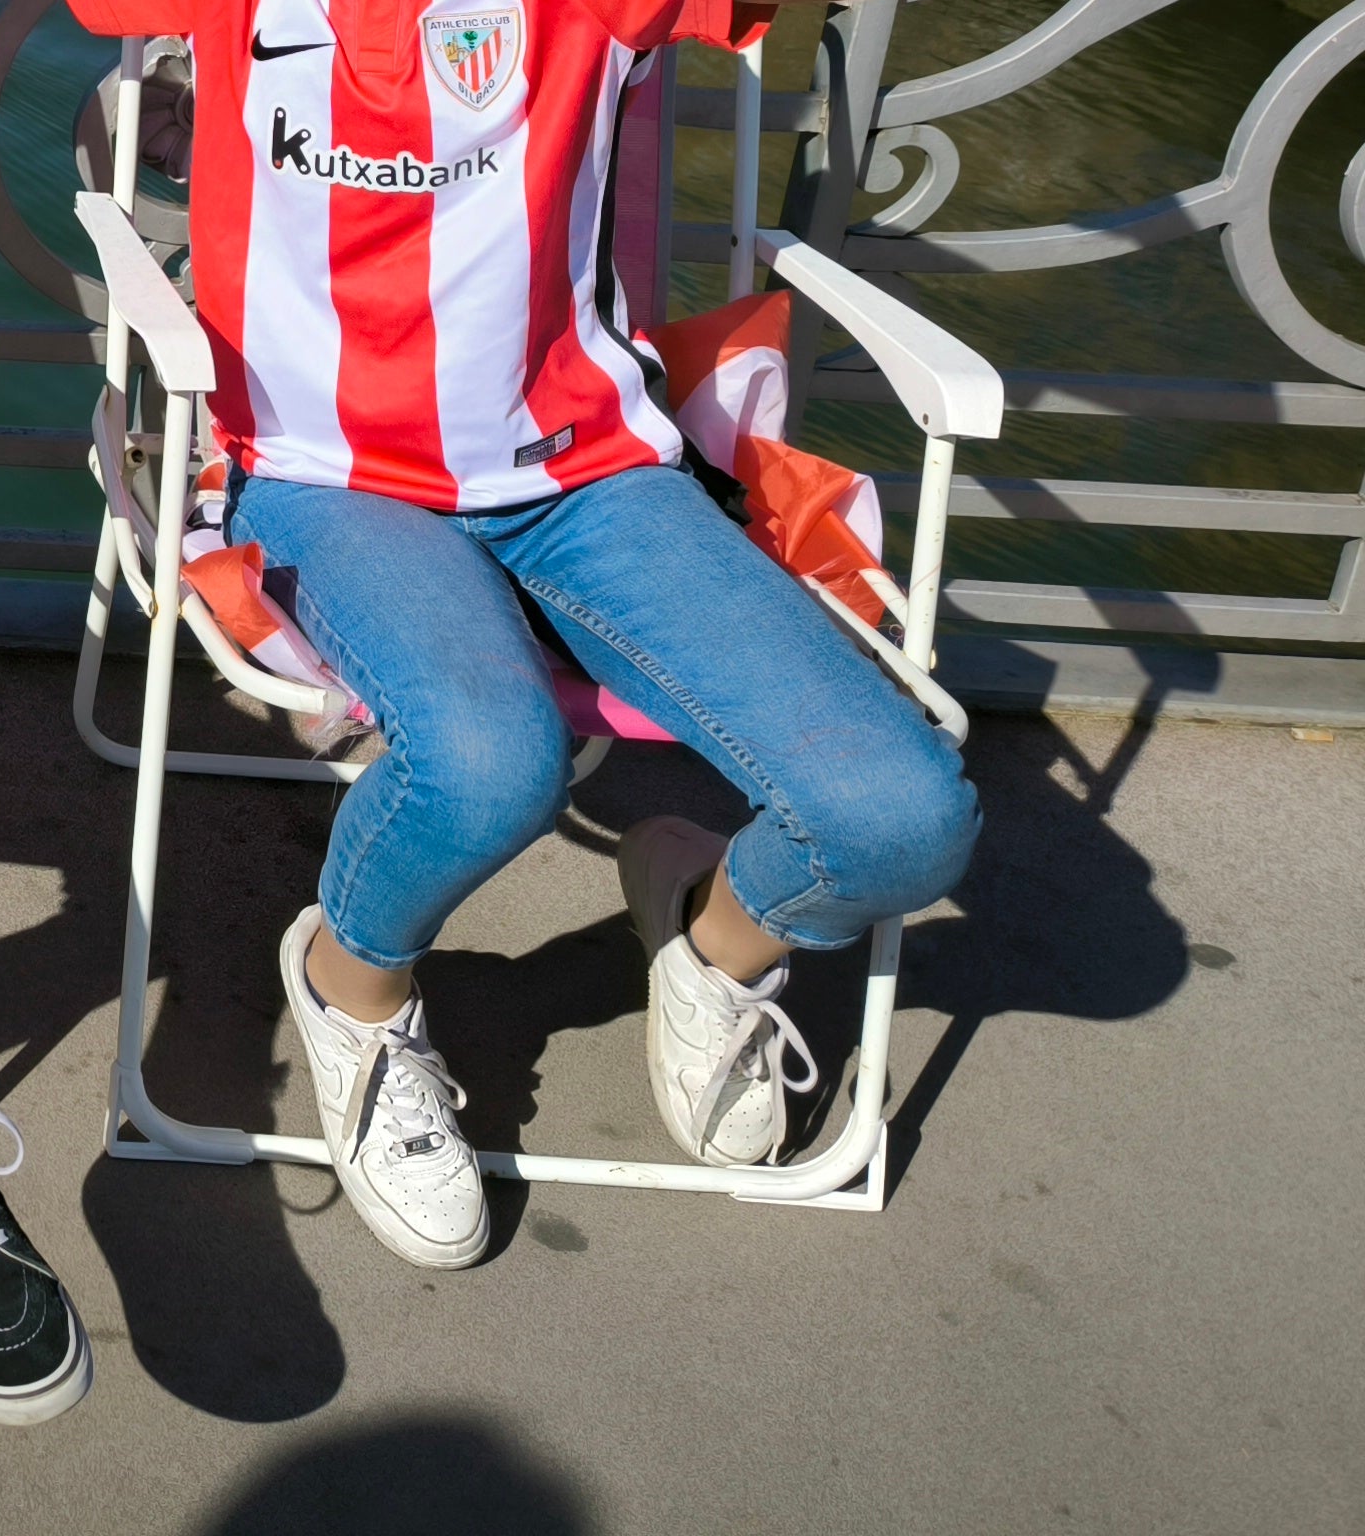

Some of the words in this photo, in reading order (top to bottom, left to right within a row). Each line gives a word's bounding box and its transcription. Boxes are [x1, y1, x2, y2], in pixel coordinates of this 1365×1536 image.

[430, 18, 480, 31] ATHLETIC
[481, 16, 511, 26] CLUB
[457, 79, 496, 105] BILBAO
[271, 106, 500, 188] Kutxabank
